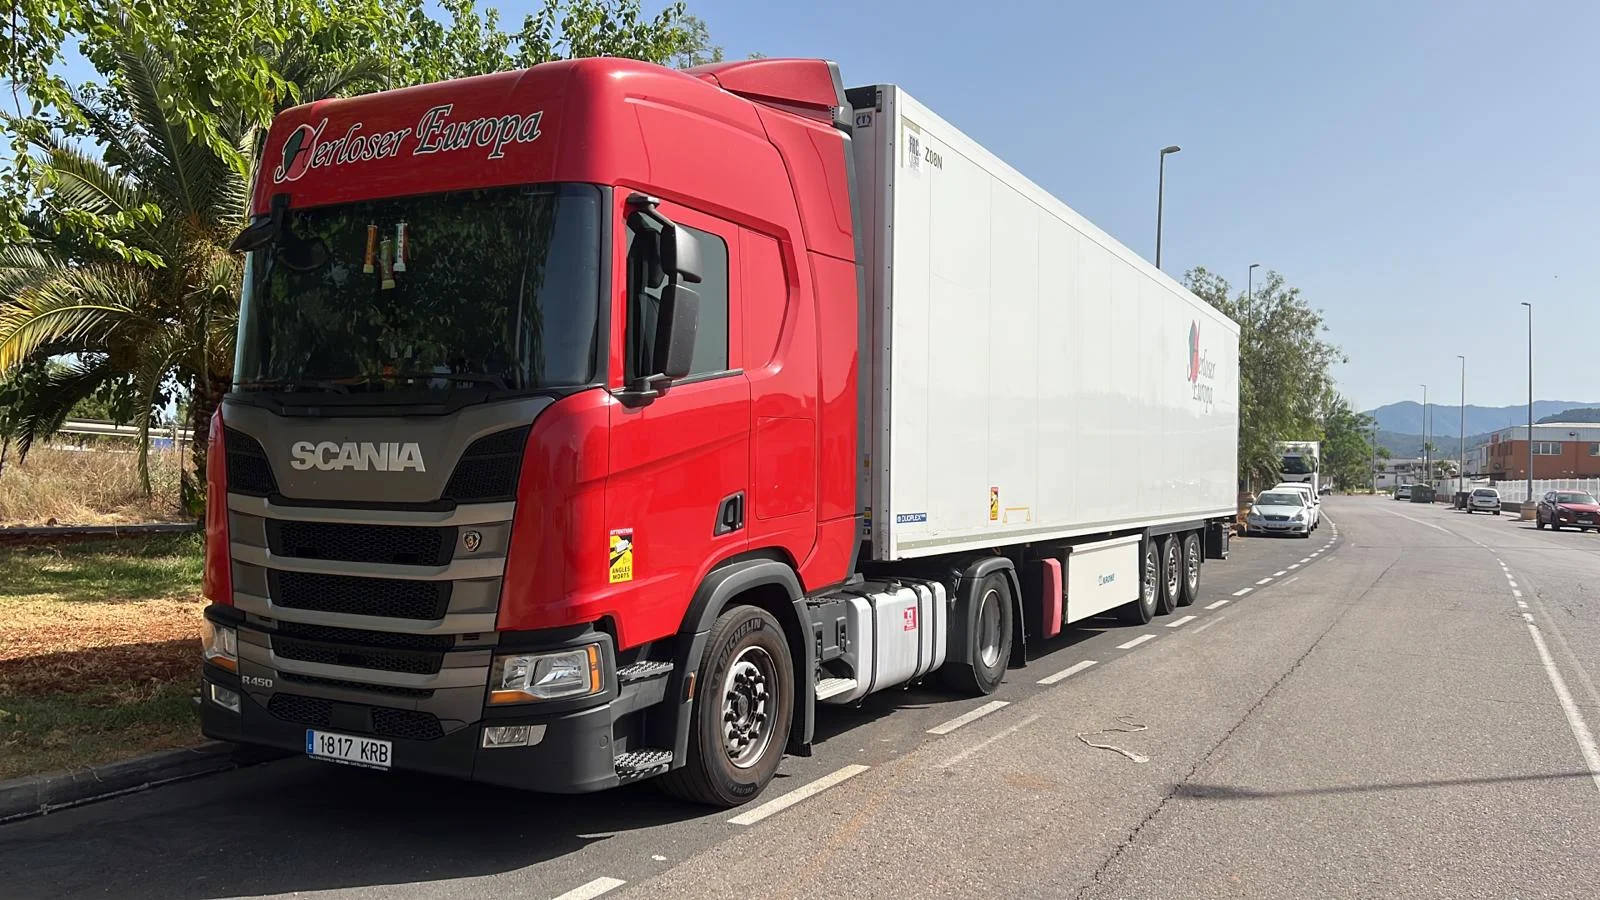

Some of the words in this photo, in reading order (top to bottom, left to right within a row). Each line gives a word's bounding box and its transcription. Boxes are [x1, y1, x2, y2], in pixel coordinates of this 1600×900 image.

[412, 103, 544, 160] Europa
[290, 441, 426, 472] SCANIA
[718, 618, 762, 668] MICHELIN
[319, 735, 353, 757] 1817
[360, 740, 388, 763] KRB
